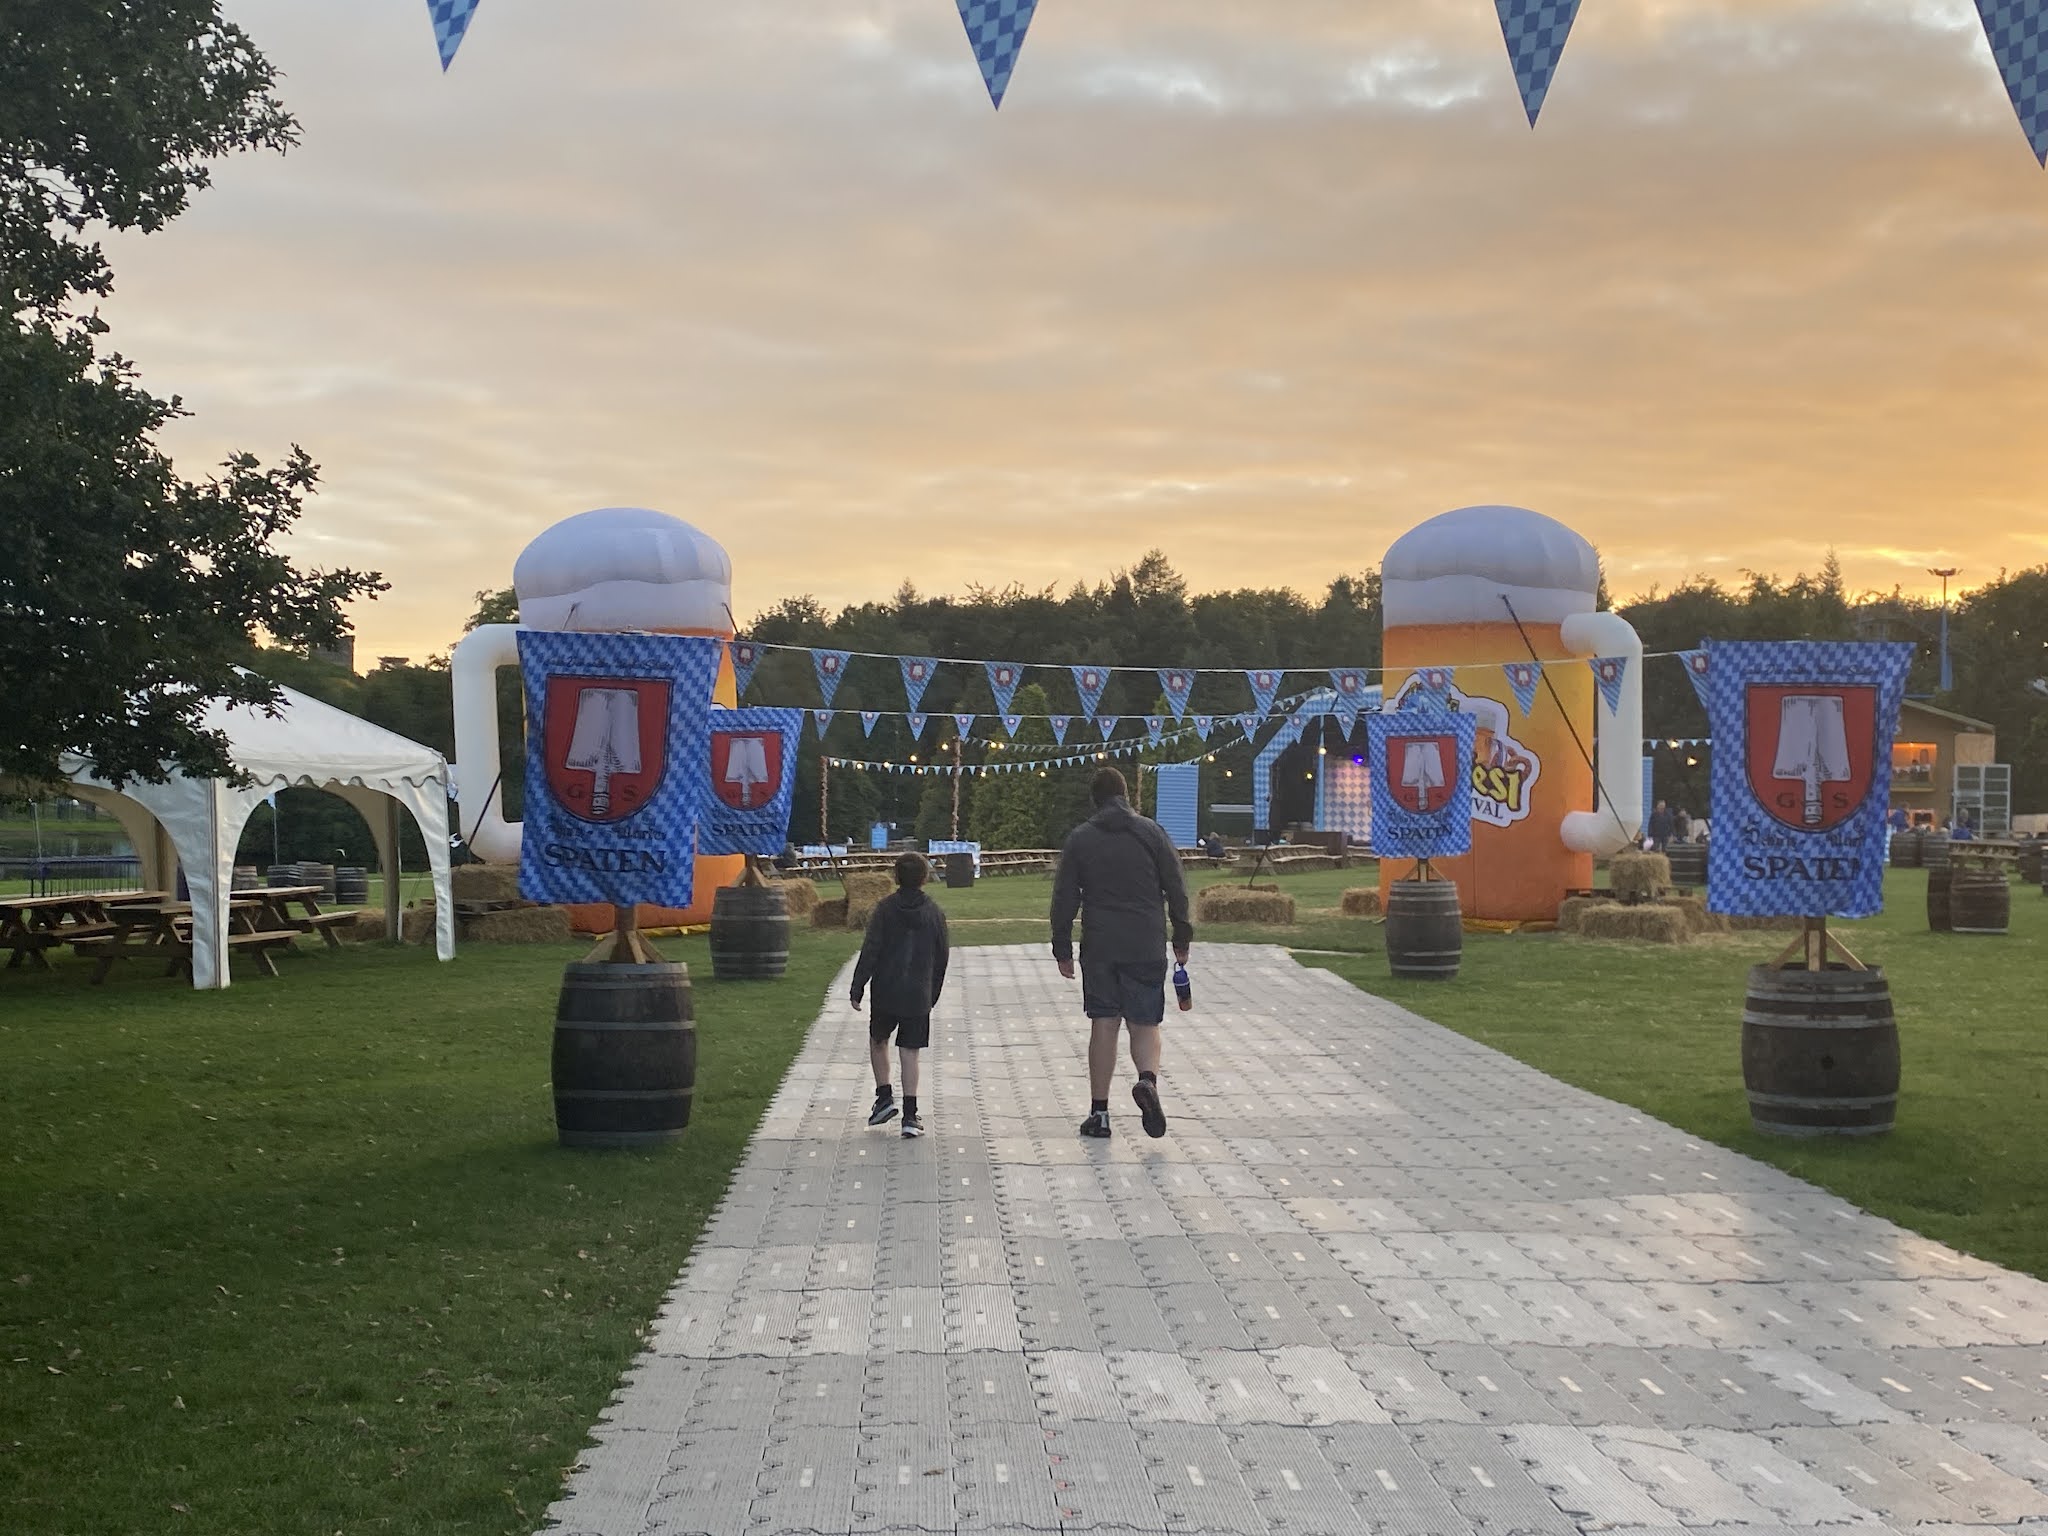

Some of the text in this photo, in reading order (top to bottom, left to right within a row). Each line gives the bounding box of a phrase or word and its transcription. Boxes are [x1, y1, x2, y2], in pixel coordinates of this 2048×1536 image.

[1472, 797, 1504, 819] VAL
[1776, 792, 1848, 808] G S
[544, 843, 667, 874] SPATEN
